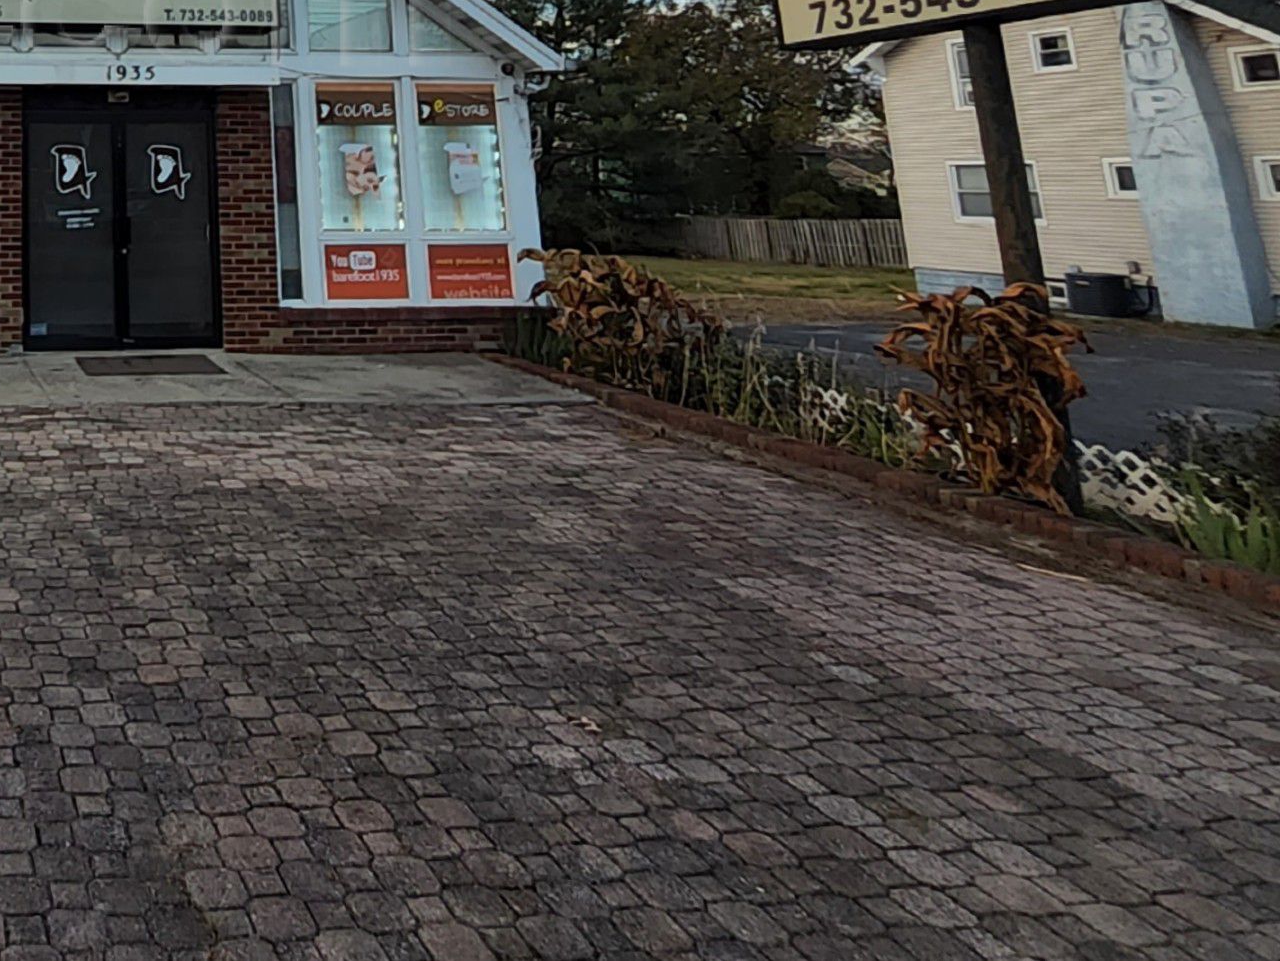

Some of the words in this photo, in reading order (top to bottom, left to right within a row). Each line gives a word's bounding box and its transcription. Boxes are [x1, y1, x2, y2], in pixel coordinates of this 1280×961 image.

[179, 10, 274, 22] 732-543-0089
[107, 65, 156, 81] 1935
[334, 103, 394, 117] COUPLE
